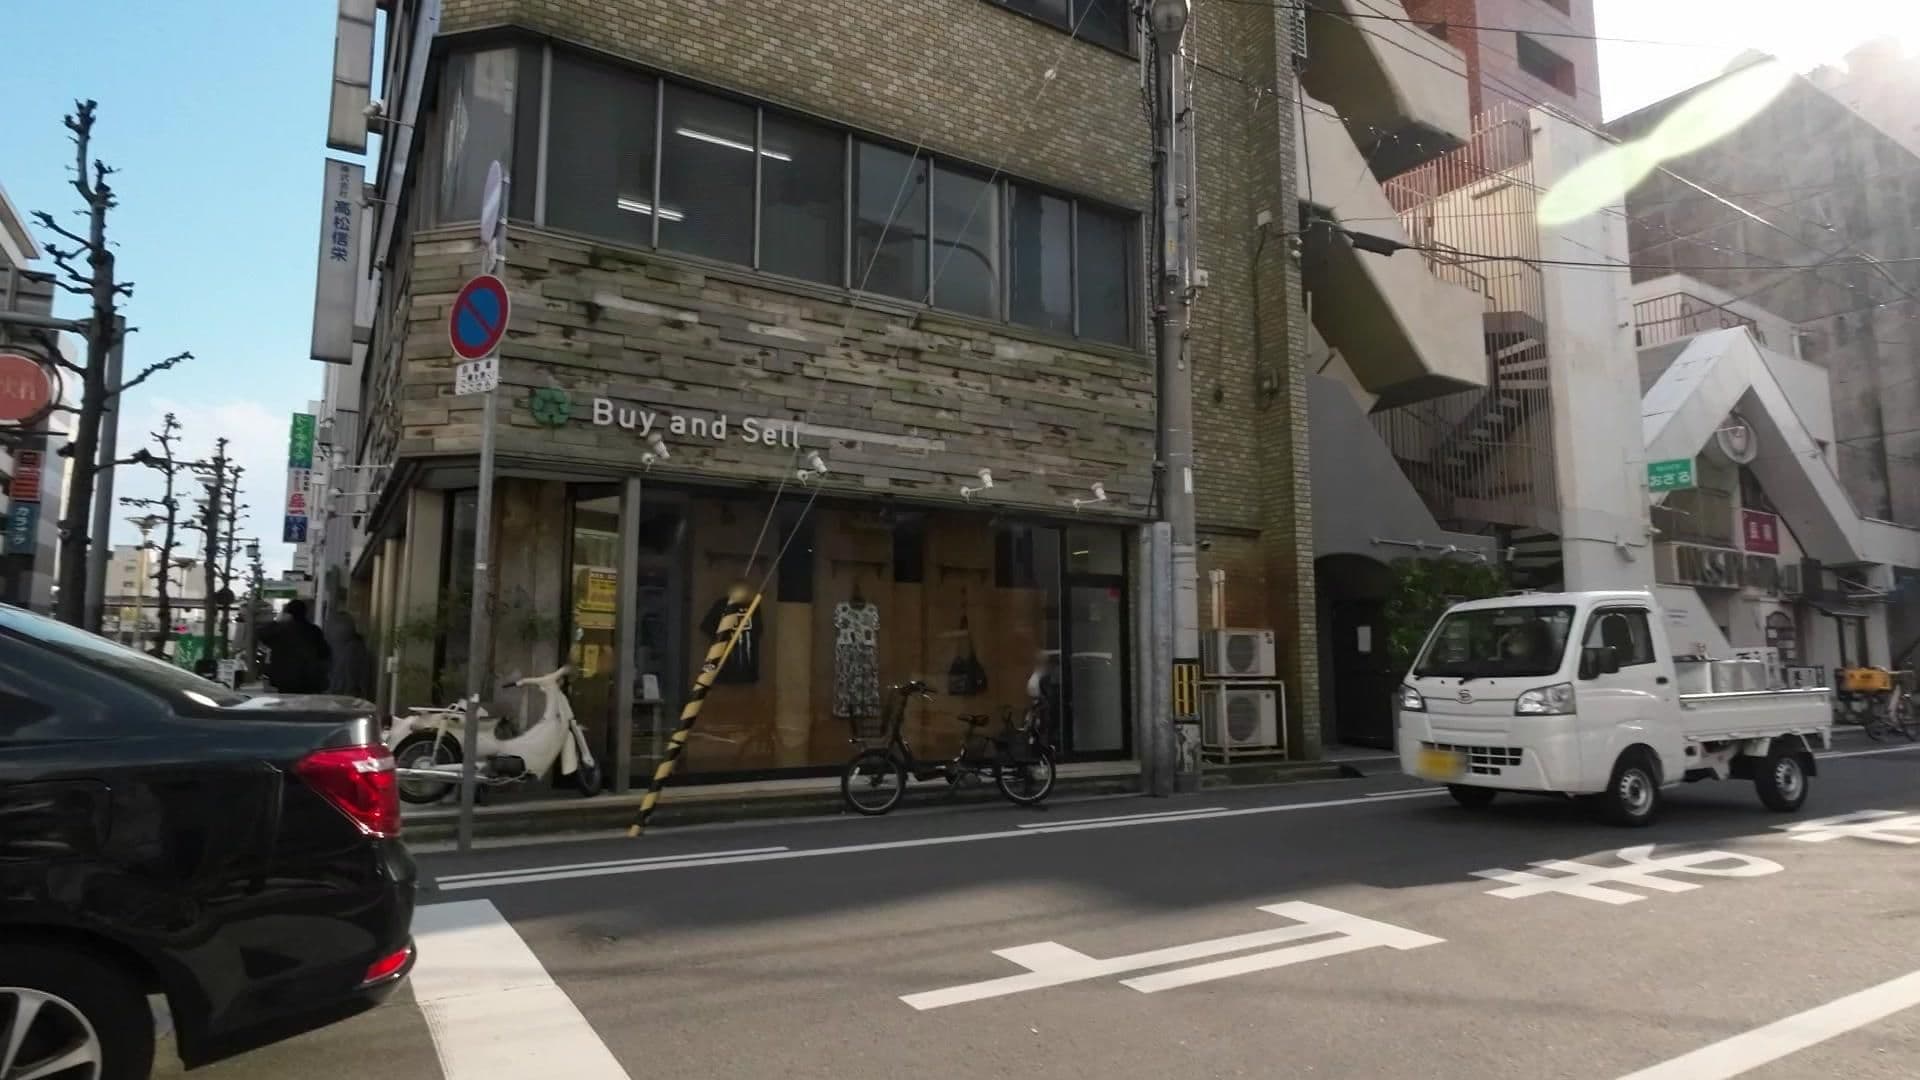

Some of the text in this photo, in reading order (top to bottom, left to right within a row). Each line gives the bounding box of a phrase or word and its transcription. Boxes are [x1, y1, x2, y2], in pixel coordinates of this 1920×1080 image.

[592, 397, 800, 449] Buy and Sell
